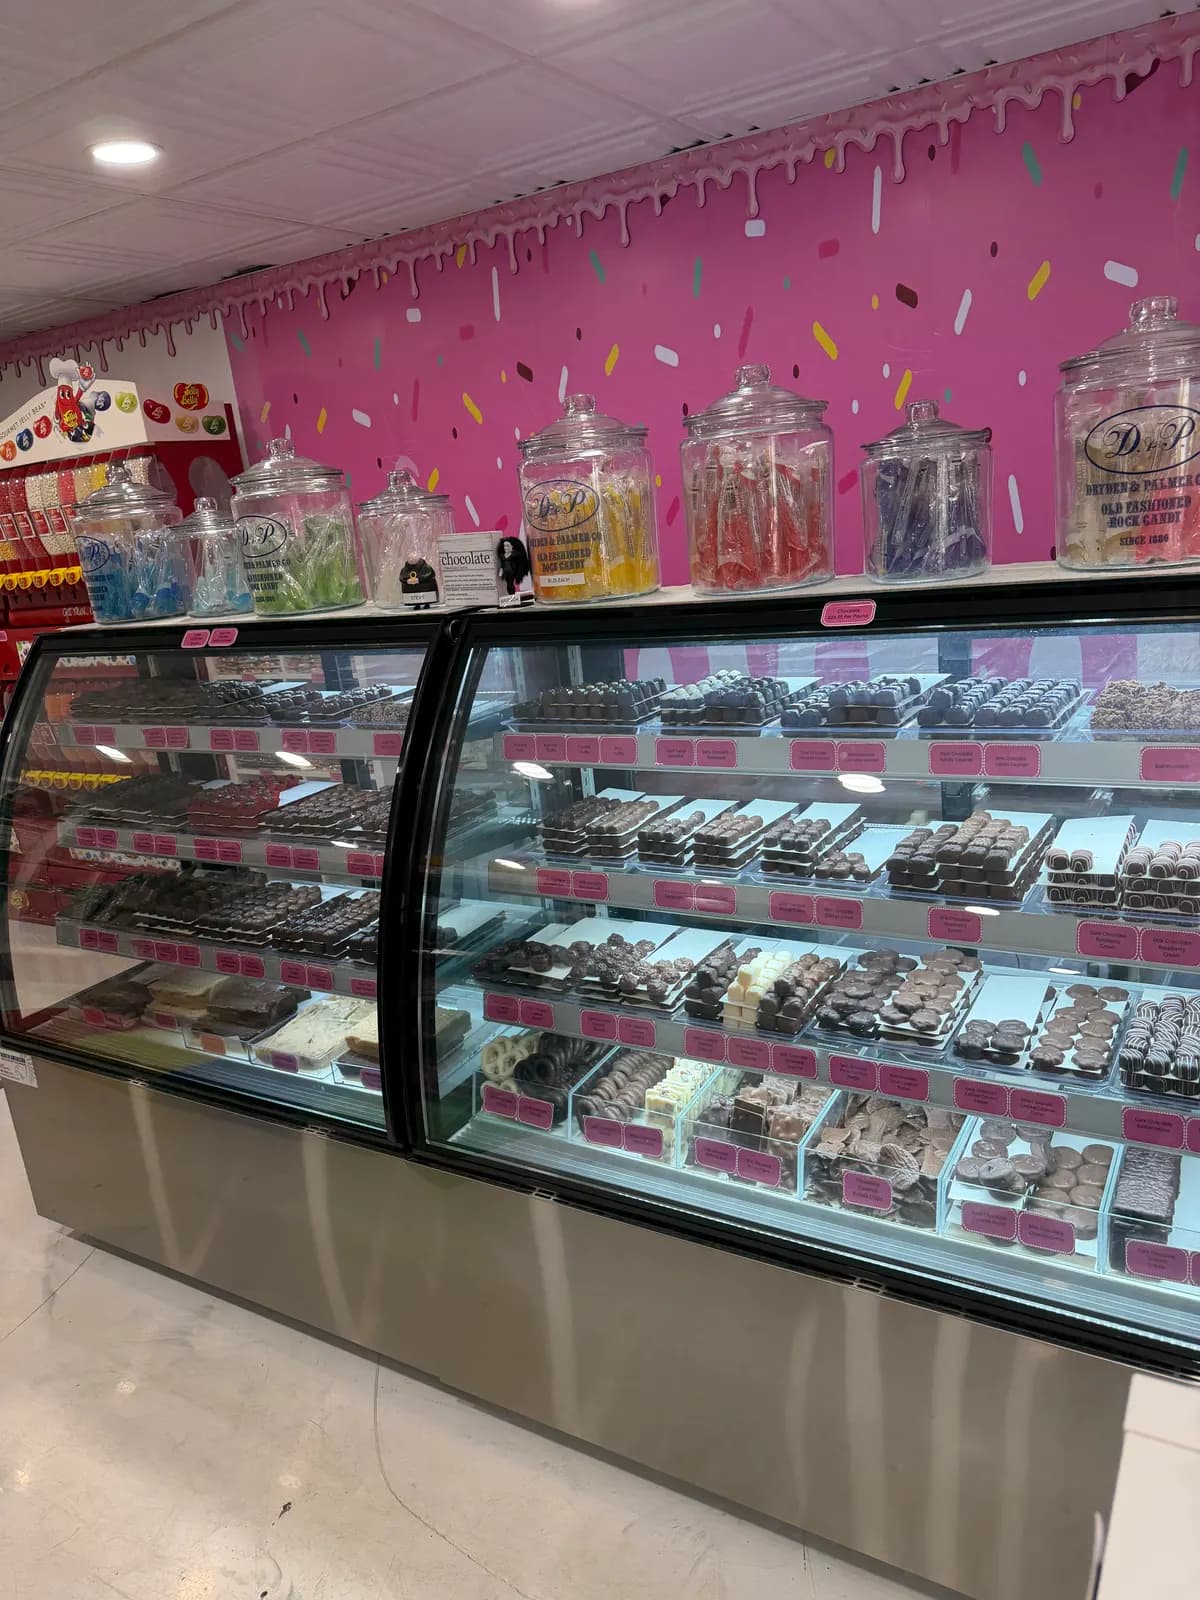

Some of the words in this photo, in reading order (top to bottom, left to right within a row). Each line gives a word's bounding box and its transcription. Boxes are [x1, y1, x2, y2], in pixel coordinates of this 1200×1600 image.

[1086, 481, 1128, 496] DRYDEN
[1129, 480, 1140, 492] &
[1144, 475, 1192, 491] PALMER
[1101, 501, 1123, 515] OLD
[1126, 496, 1191, 513] FASHIONED
[1108, 515, 1140, 529] ROCK
[1143, 511, 1182, 526] CANDY
[1120, 535, 1146, 546] SINCE
[441, 551, 490, 566] chocolate
